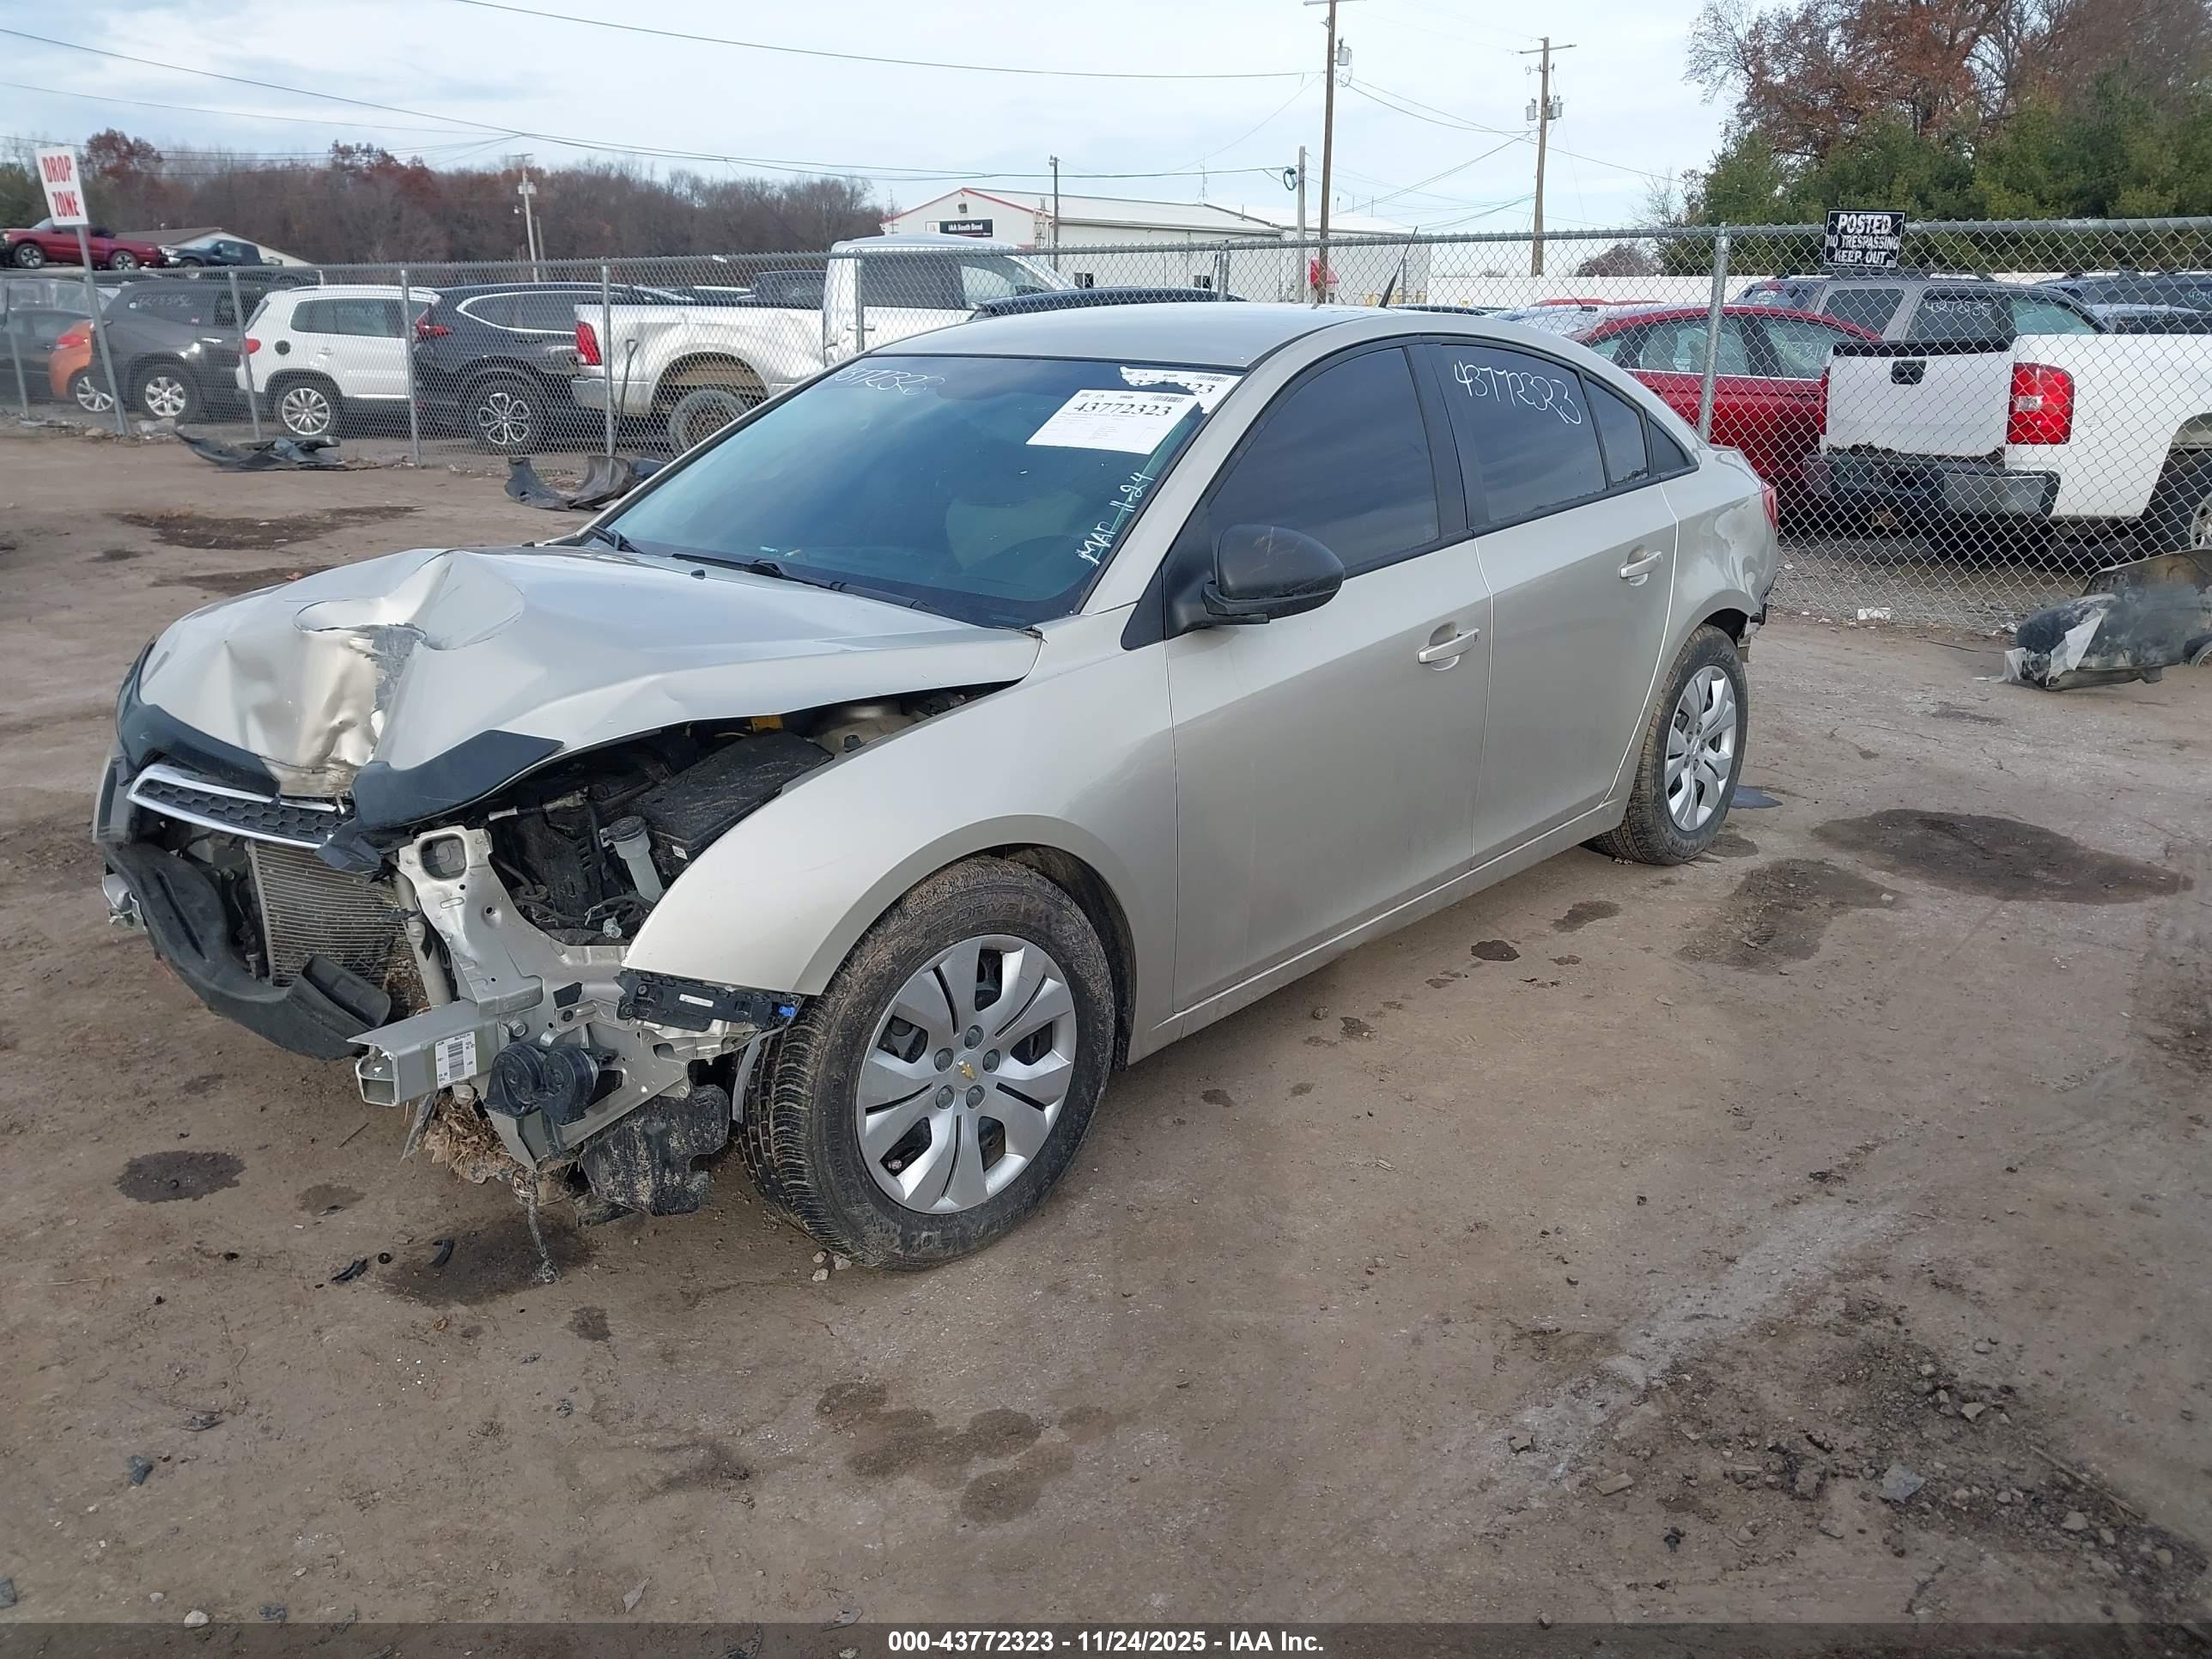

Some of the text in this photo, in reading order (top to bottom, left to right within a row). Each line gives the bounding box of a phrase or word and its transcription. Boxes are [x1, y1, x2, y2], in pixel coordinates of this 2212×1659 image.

[41, 155, 72, 183] DROP
[52, 191, 81, 217] ZONE
[1838, 214, 1892, 234] POSTED
[1826, 234, 1899, 250] NO TRESPASSING
[1834, 249, 1887, 264] KEEP OUT
[1454, 360, 1582, 424] 43772323
[1073, 402, 1172, 416] 43772323
